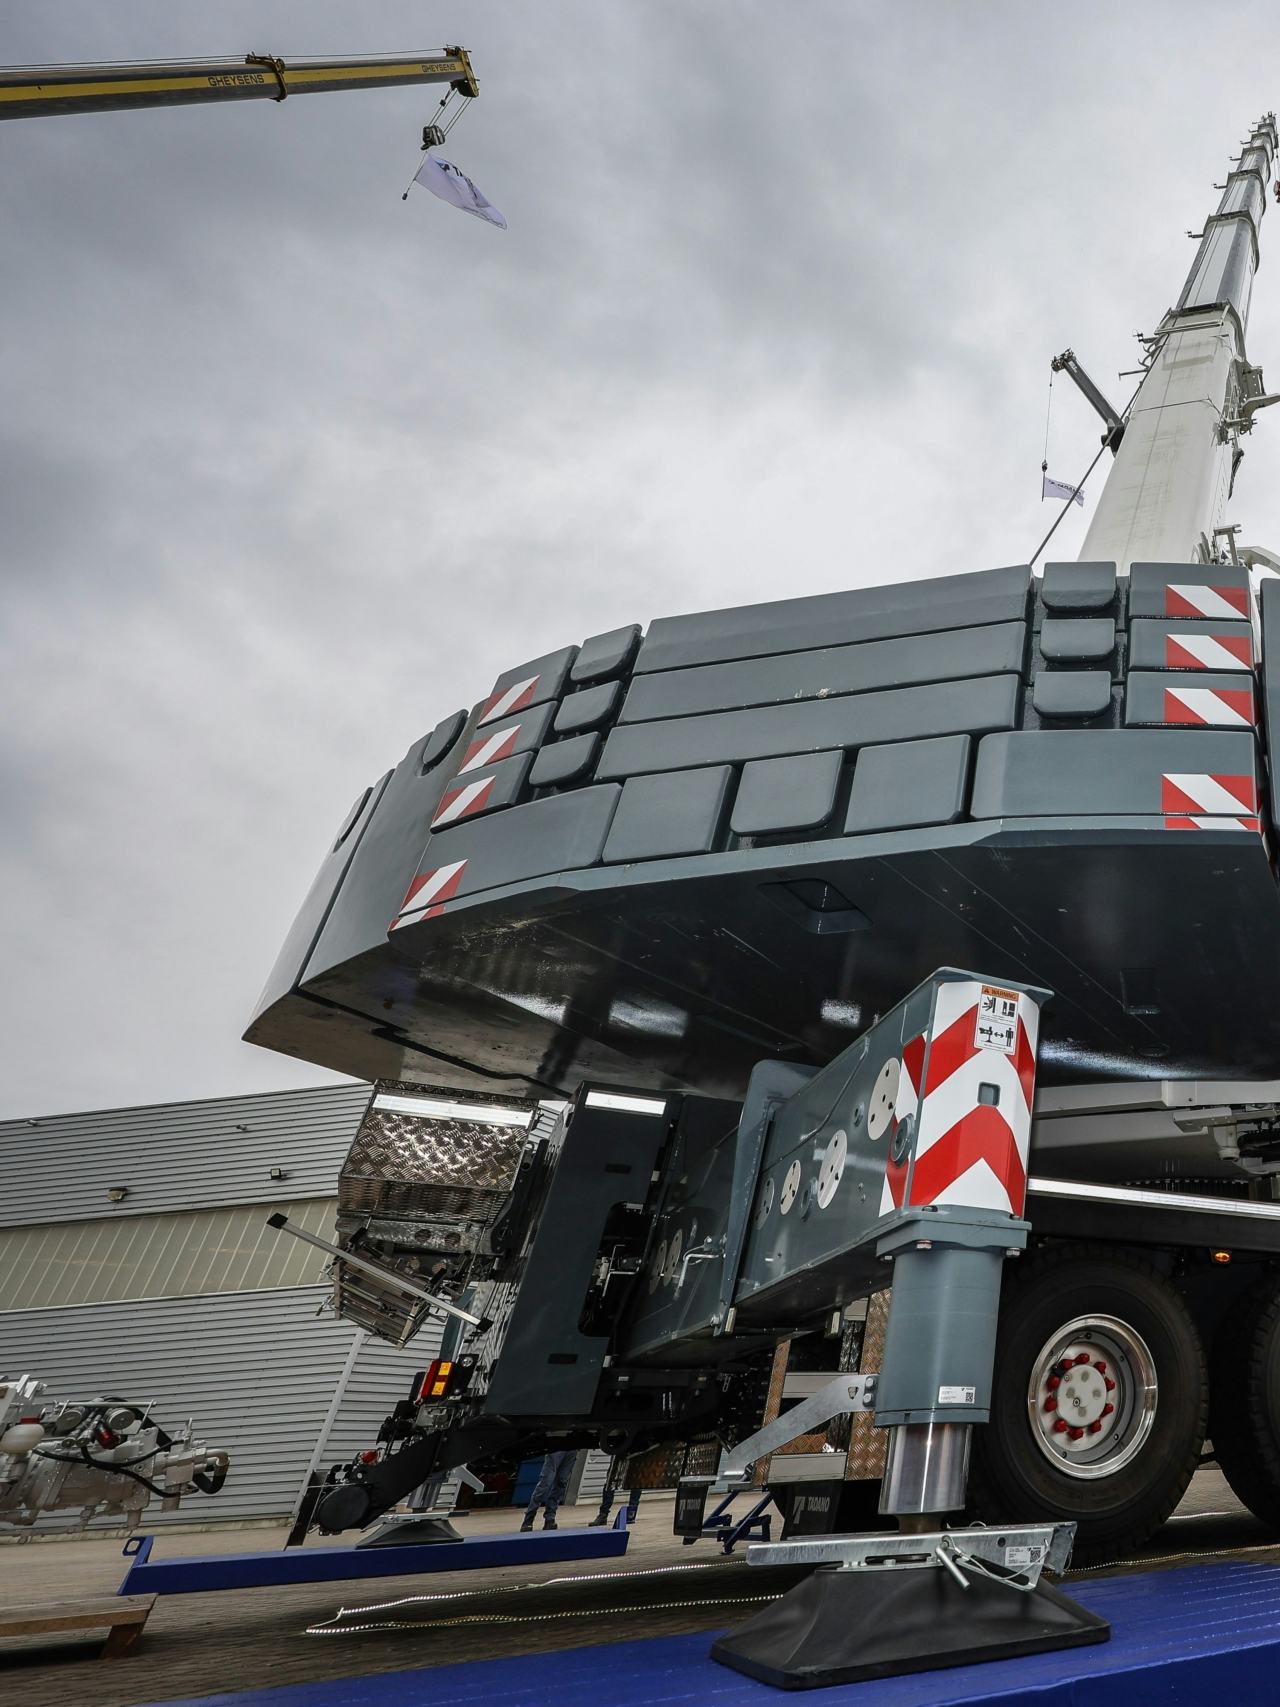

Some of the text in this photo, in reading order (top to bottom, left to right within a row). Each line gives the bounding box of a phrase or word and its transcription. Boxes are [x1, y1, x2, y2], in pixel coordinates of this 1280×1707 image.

[421, 63, 456, 73] GHEYSENS
[208, 74, 265, 87] GHEYSENS
[991, 988, 1016, 1000] WARNING
[807, 1496, 830, 1512] TADANO
